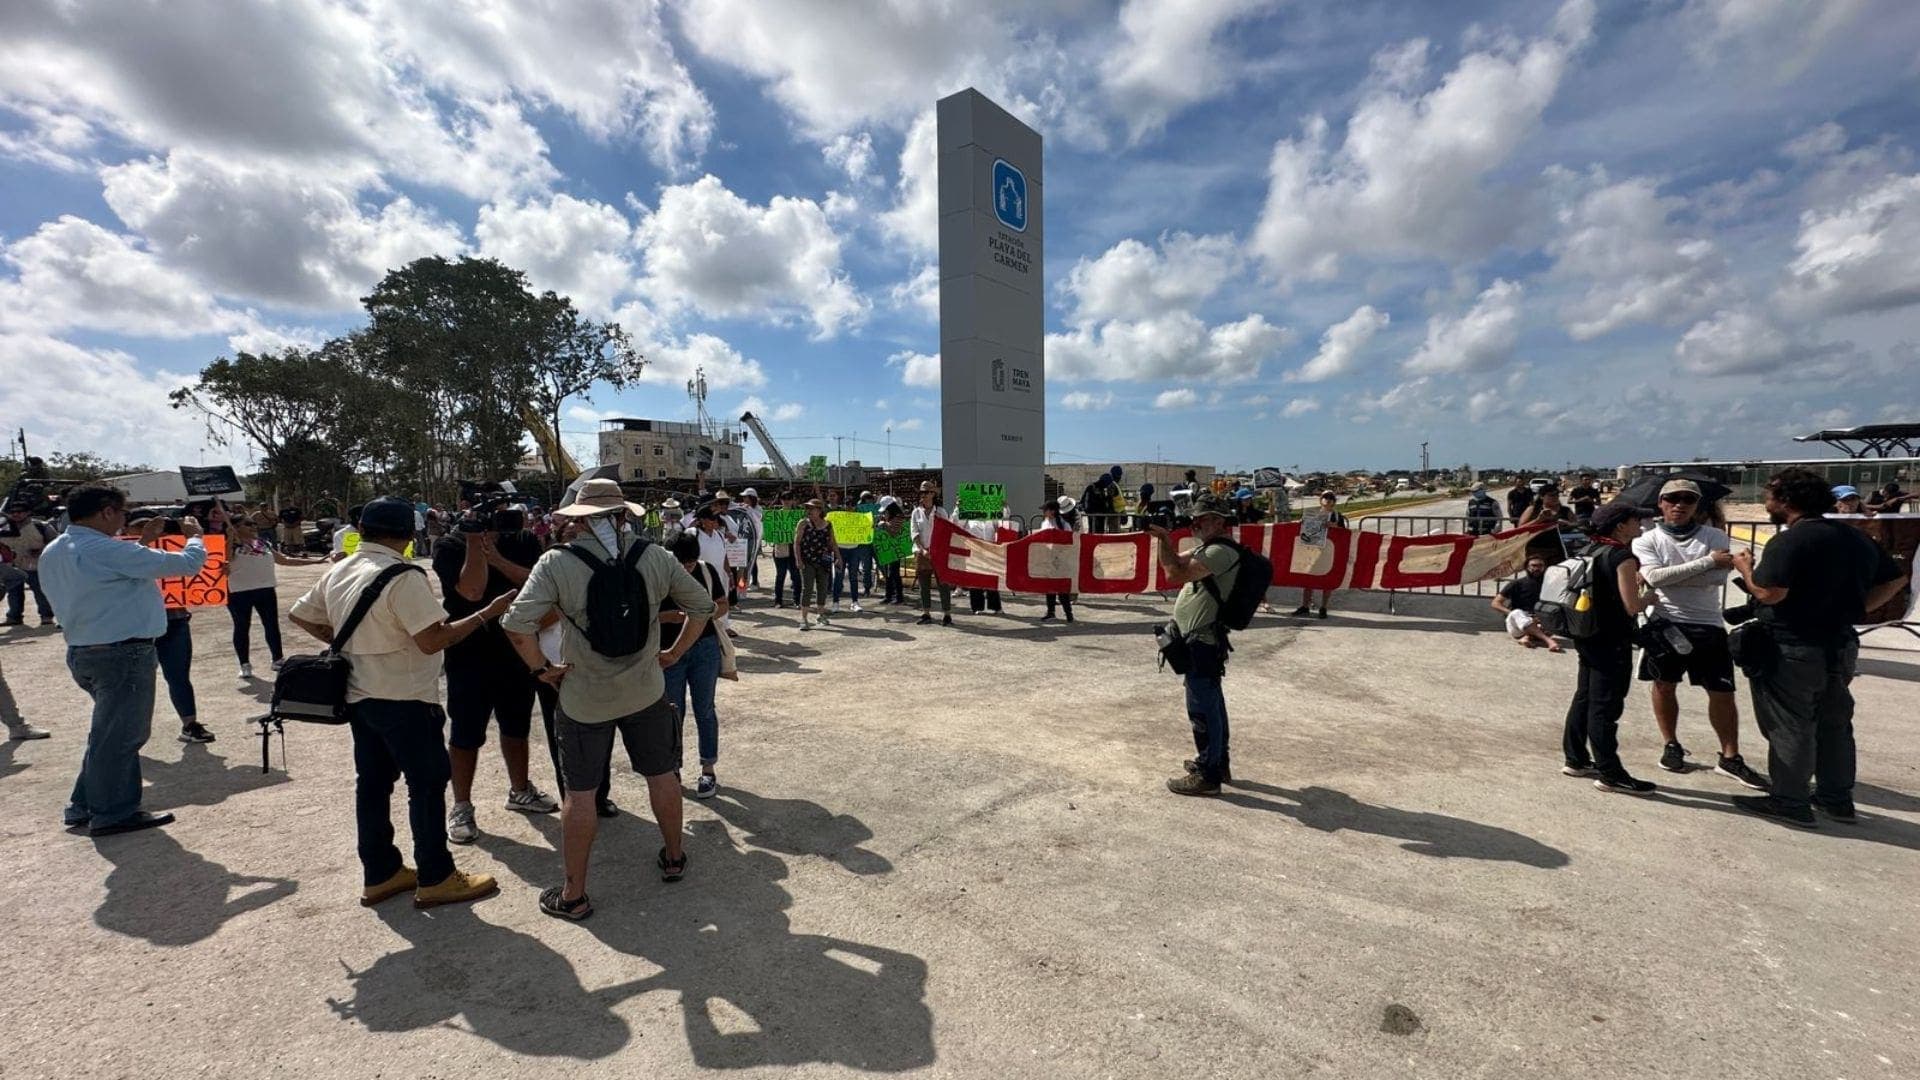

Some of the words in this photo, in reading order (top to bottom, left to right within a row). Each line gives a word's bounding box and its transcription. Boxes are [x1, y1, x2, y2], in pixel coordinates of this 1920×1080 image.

[989, 236, 1016, 257] PLAYA
[1016, 248, 1032, 264] DEL
[994, 252, 1029, 274] CARMEN
[1013, 368, 1029, 379] TREN
[1012, 377, 1031, 388] MAYA
[980, 484, 1003, 496] LEY
